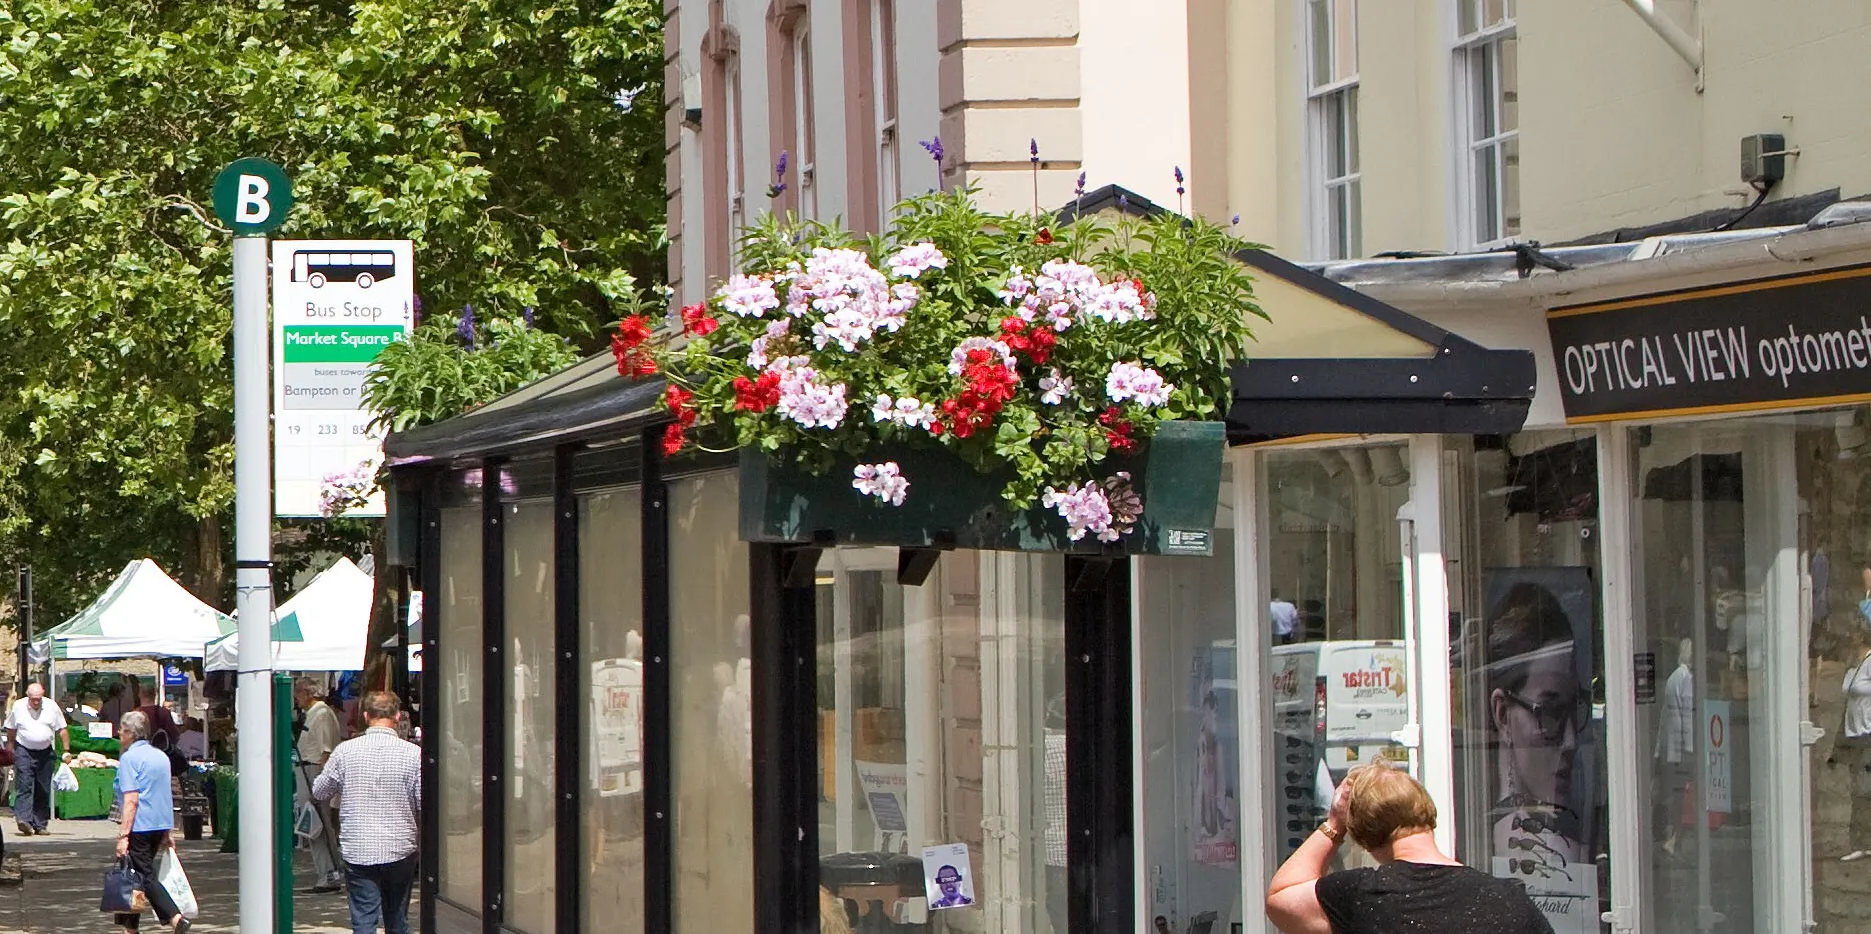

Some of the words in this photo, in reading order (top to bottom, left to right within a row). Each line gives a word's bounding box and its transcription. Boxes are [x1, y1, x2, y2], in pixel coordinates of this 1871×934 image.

[235, 173, 271, 225] B
[306, 301, 336, 318] Bus
[343, 301, 383, 322] Stop
[285, 331, 338, 345] Market
[340, 331, 389, 348] Square
[392, 332, 403, 343] B
[1564, 335, 1677, 396] OPTICAL
[1672, 325, 1751, 383] VIEW
[314, 367, 338, 376] buses
[285, 384, 339, 398] Bampton
[343, 388, 357, 396] or
[288, 424, 301, 435] 19
[318, 424, 338, 435] 233
